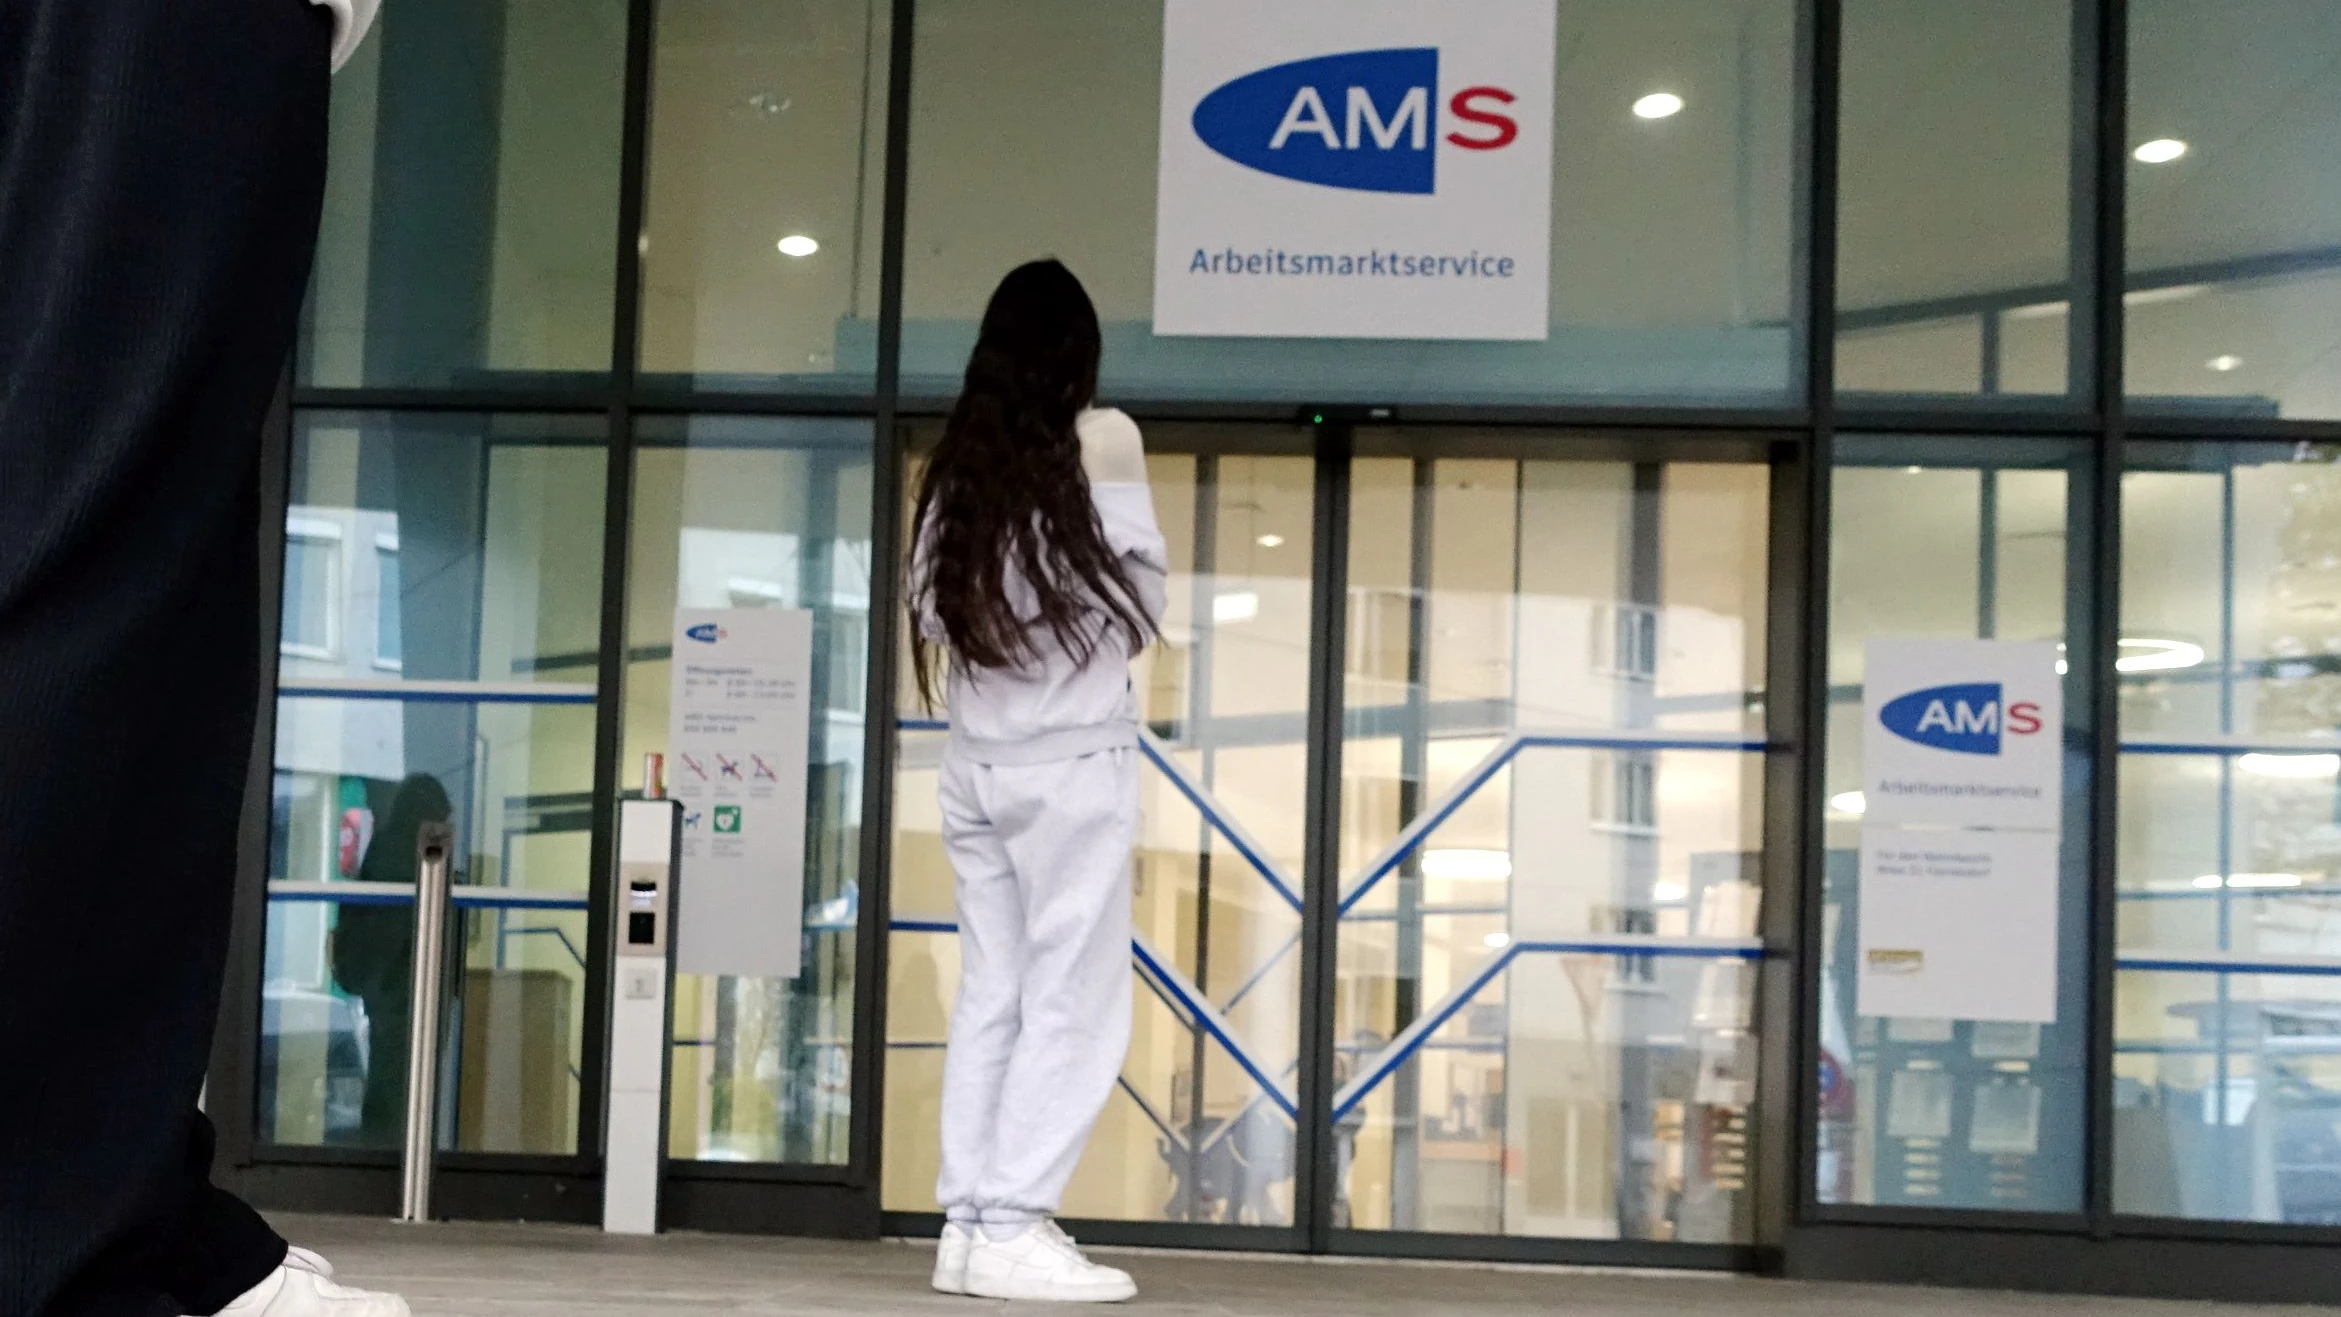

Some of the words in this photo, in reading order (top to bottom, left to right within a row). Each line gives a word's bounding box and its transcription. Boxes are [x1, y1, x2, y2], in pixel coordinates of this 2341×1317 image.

[1268, 86, 1518, 151] AMS
[1189, 248, 1515, 277] Arbeitsmarktservice
[1916, 699, 2042, 734] AMS
